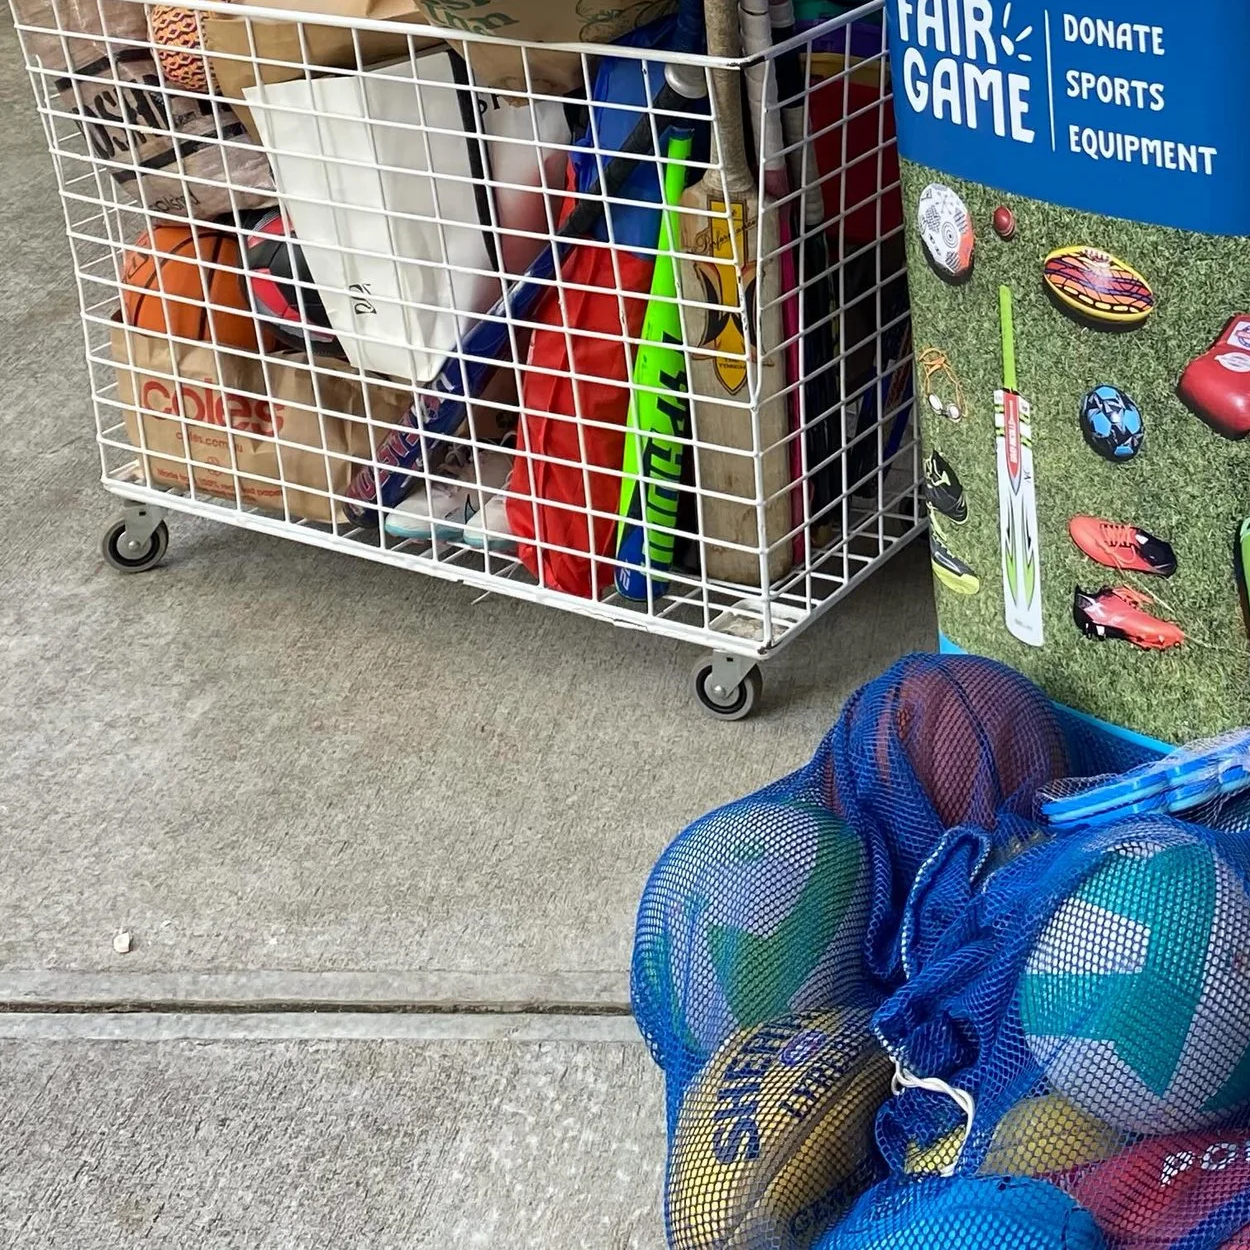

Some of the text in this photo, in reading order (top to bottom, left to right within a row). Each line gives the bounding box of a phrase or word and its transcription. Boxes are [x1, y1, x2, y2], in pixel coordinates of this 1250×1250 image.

[1063, 13, 1165, 56] DONATE
[903, 47, 1036, 143] GAME
[1065, 69, 1165, 111] SPORTS
[1069, 124, 1217, 175] EQUIPMENT
[176, 431, 243, 453] cles.comu
